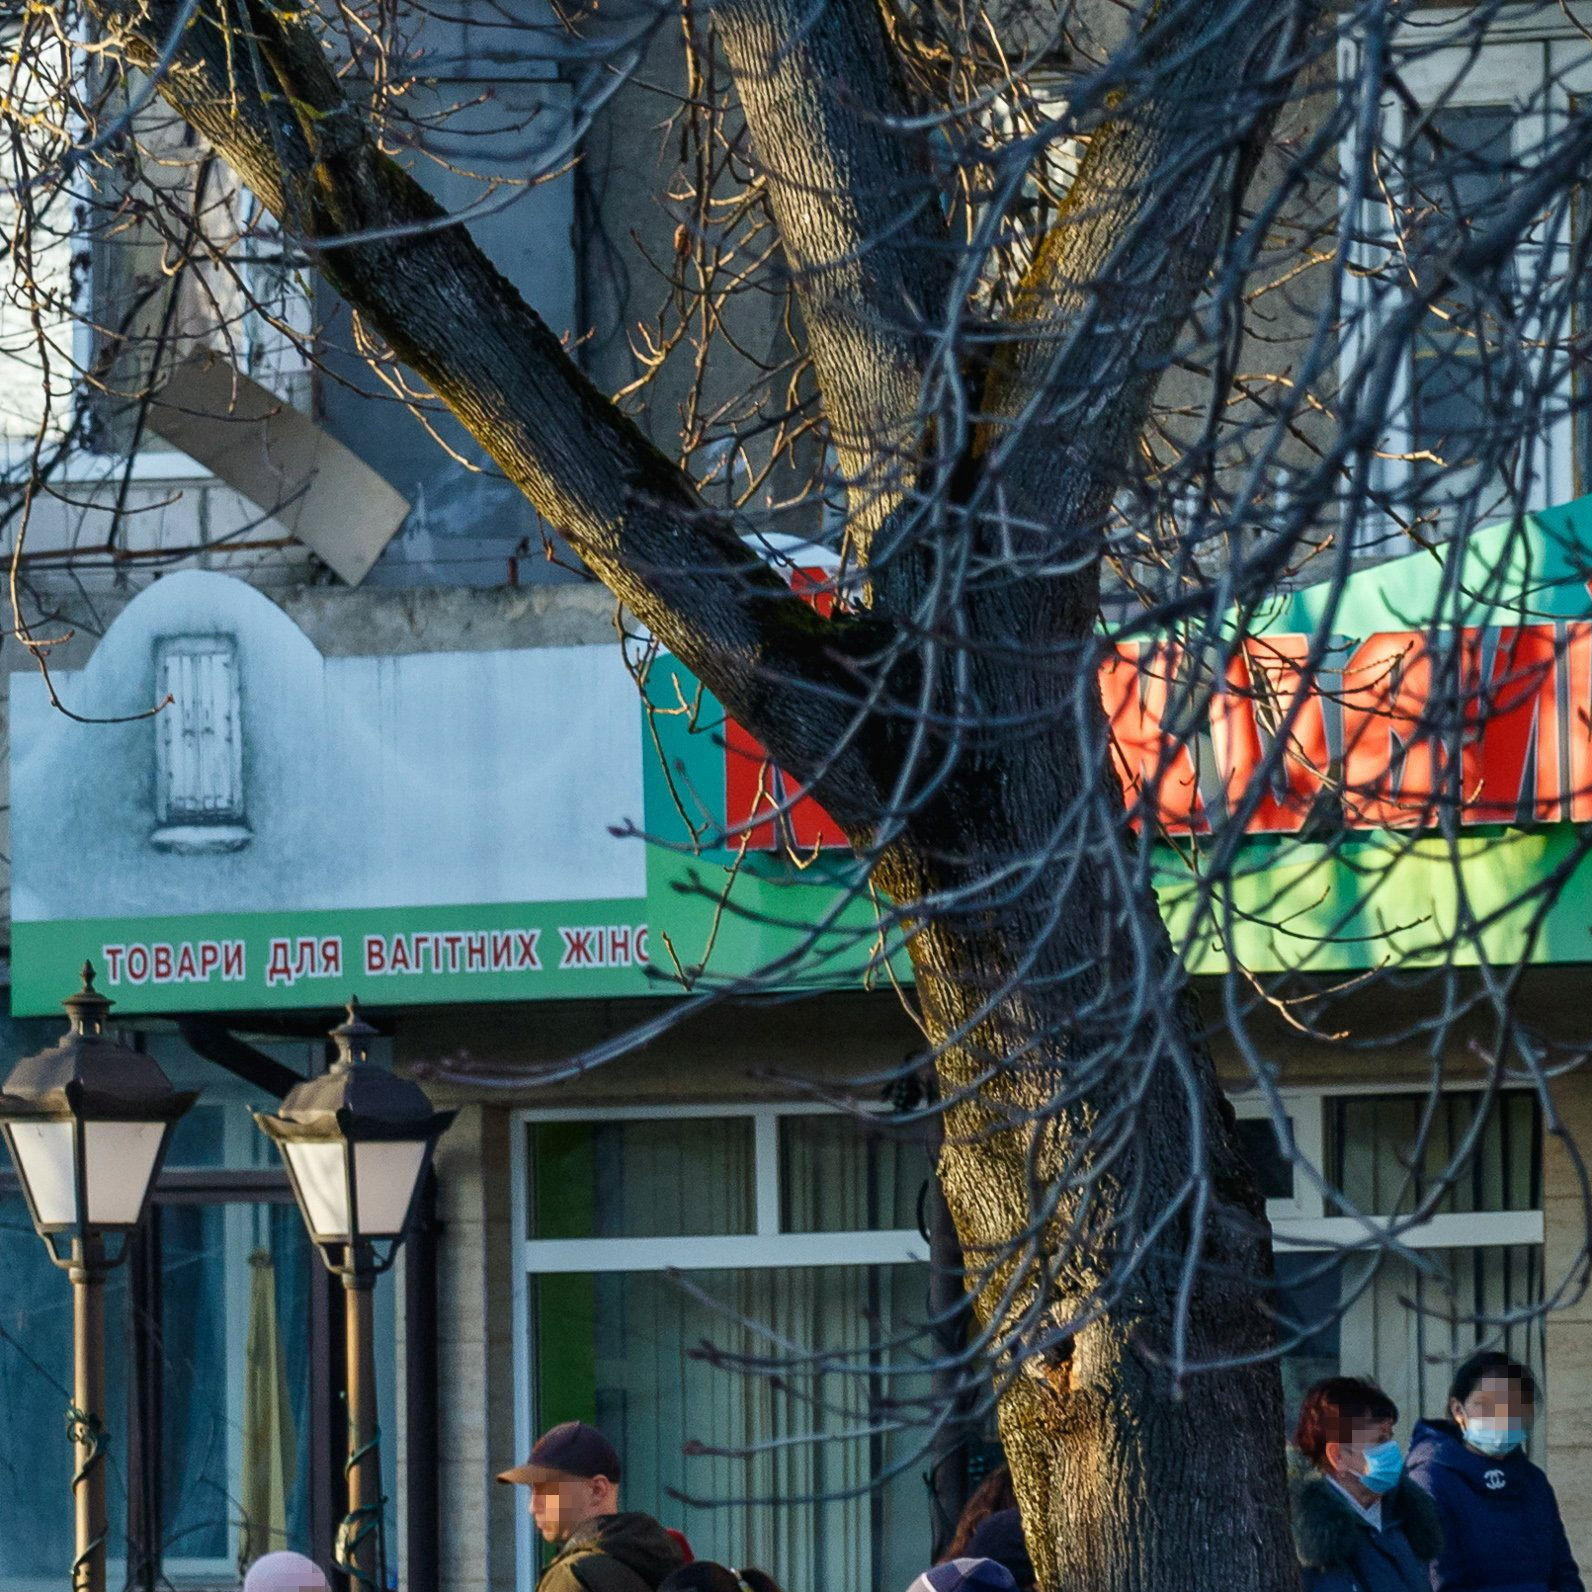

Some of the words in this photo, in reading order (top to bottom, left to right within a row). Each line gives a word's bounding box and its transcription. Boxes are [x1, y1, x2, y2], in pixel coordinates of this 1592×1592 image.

[103, 938, 246, 986] ТОВАРИ
[266, 936, 342, 987] ДЛЯ
[364, 927, 542, 975] ВАГІТНИХ
